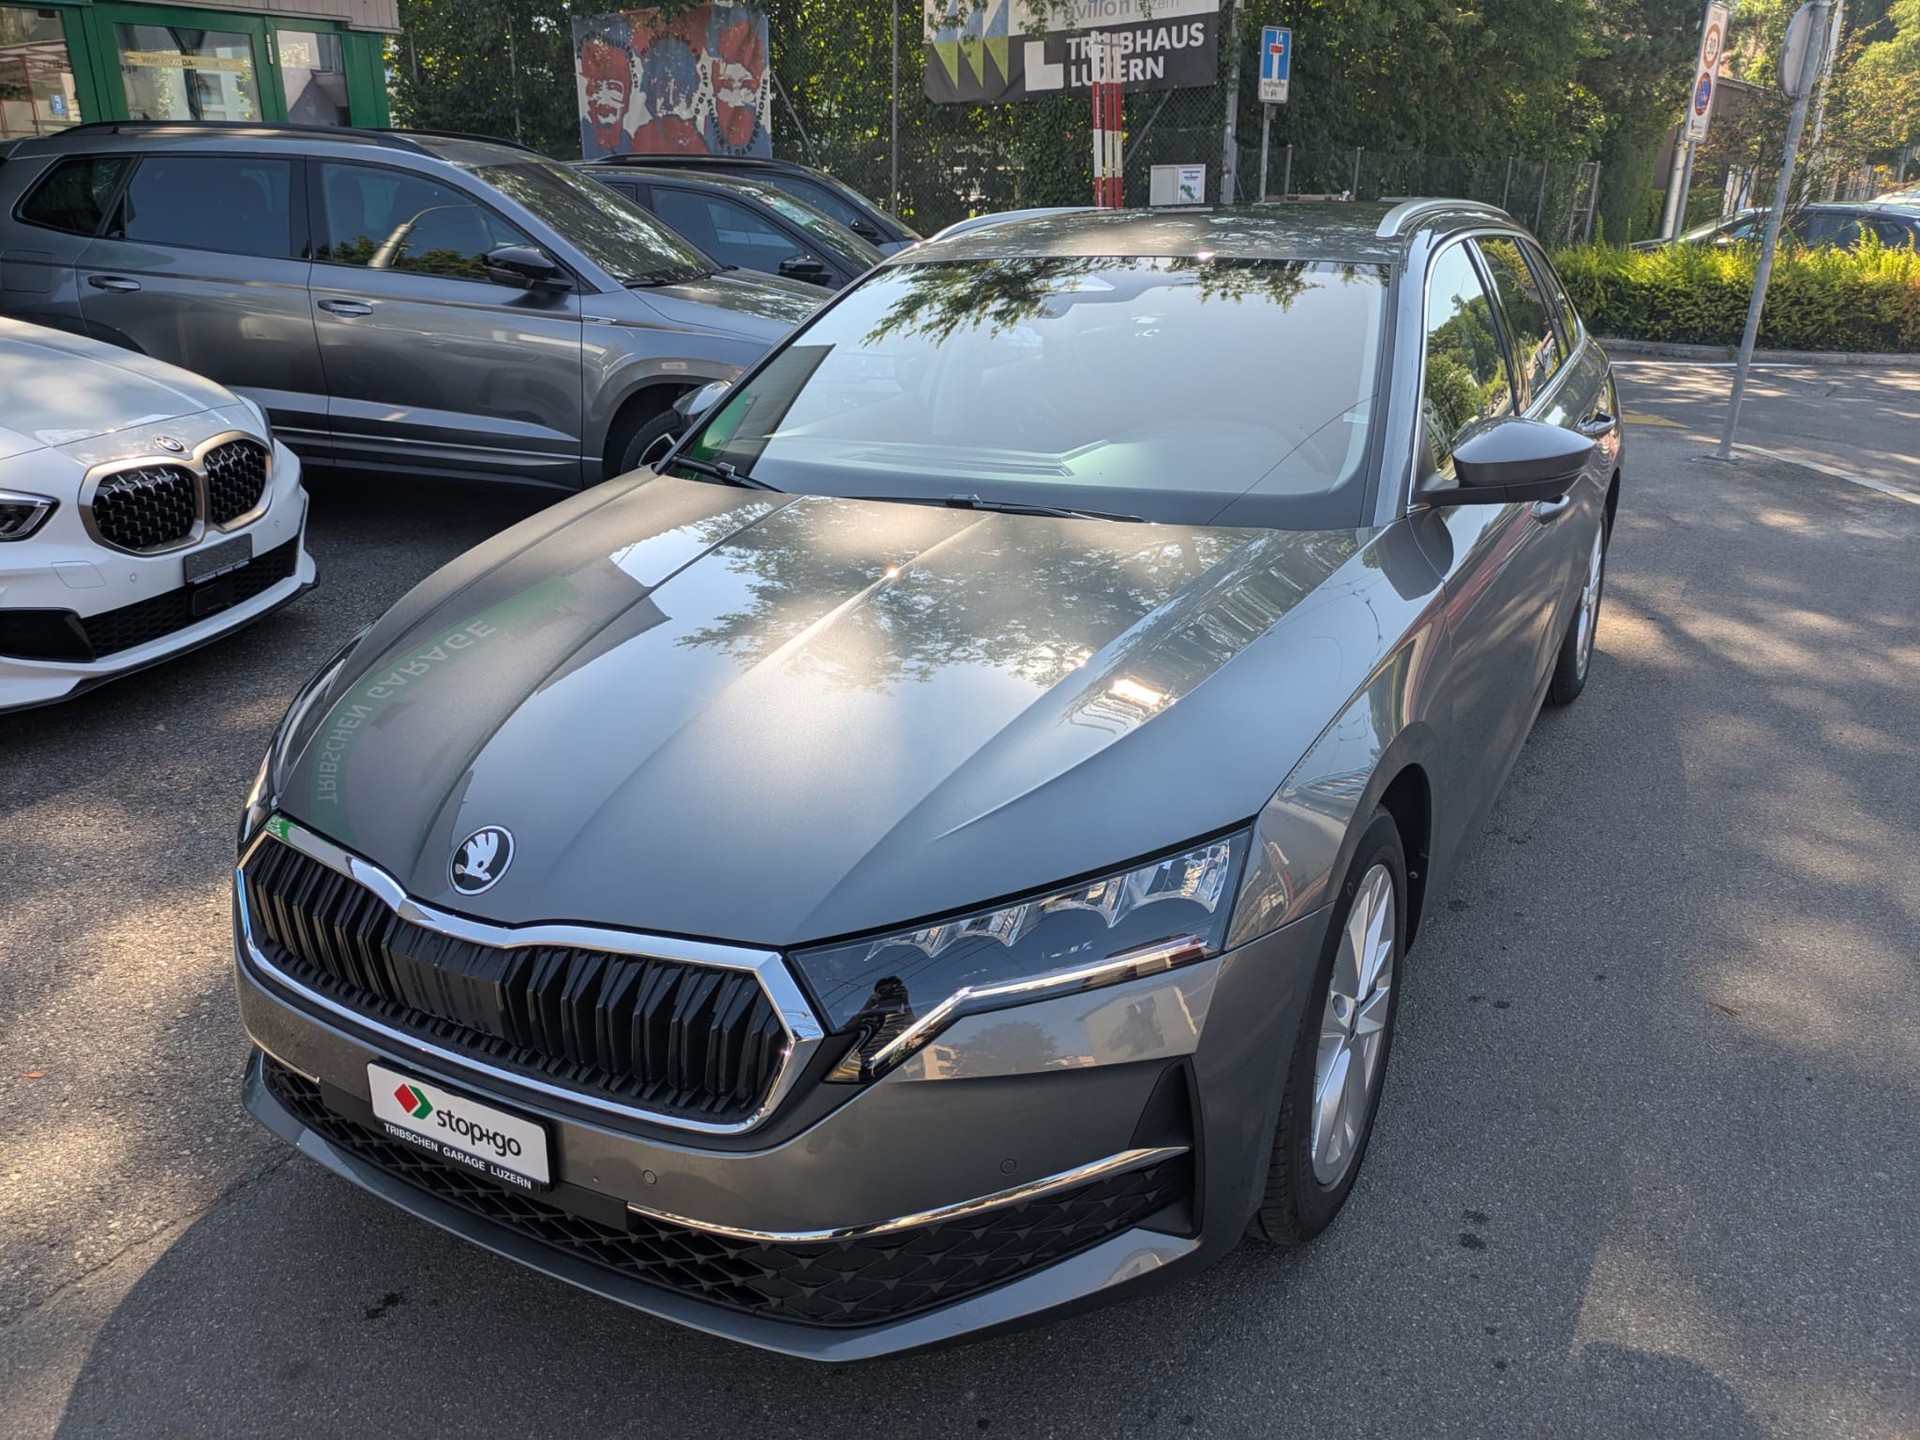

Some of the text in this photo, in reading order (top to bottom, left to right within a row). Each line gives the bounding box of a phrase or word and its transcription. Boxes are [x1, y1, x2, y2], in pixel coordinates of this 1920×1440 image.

[1134, 0, 1180, 13] Lzern
[1066, 23, 1204, 60] TRBHAUS
[1707, 37, 1717, 56] 30
[1071, 56, 1164, 88] LUERN
[436, 1108, 522, 1157] stop+go
[383, 1122, 532, 1190] TRIBSCHEN GARAGE LUZERN
